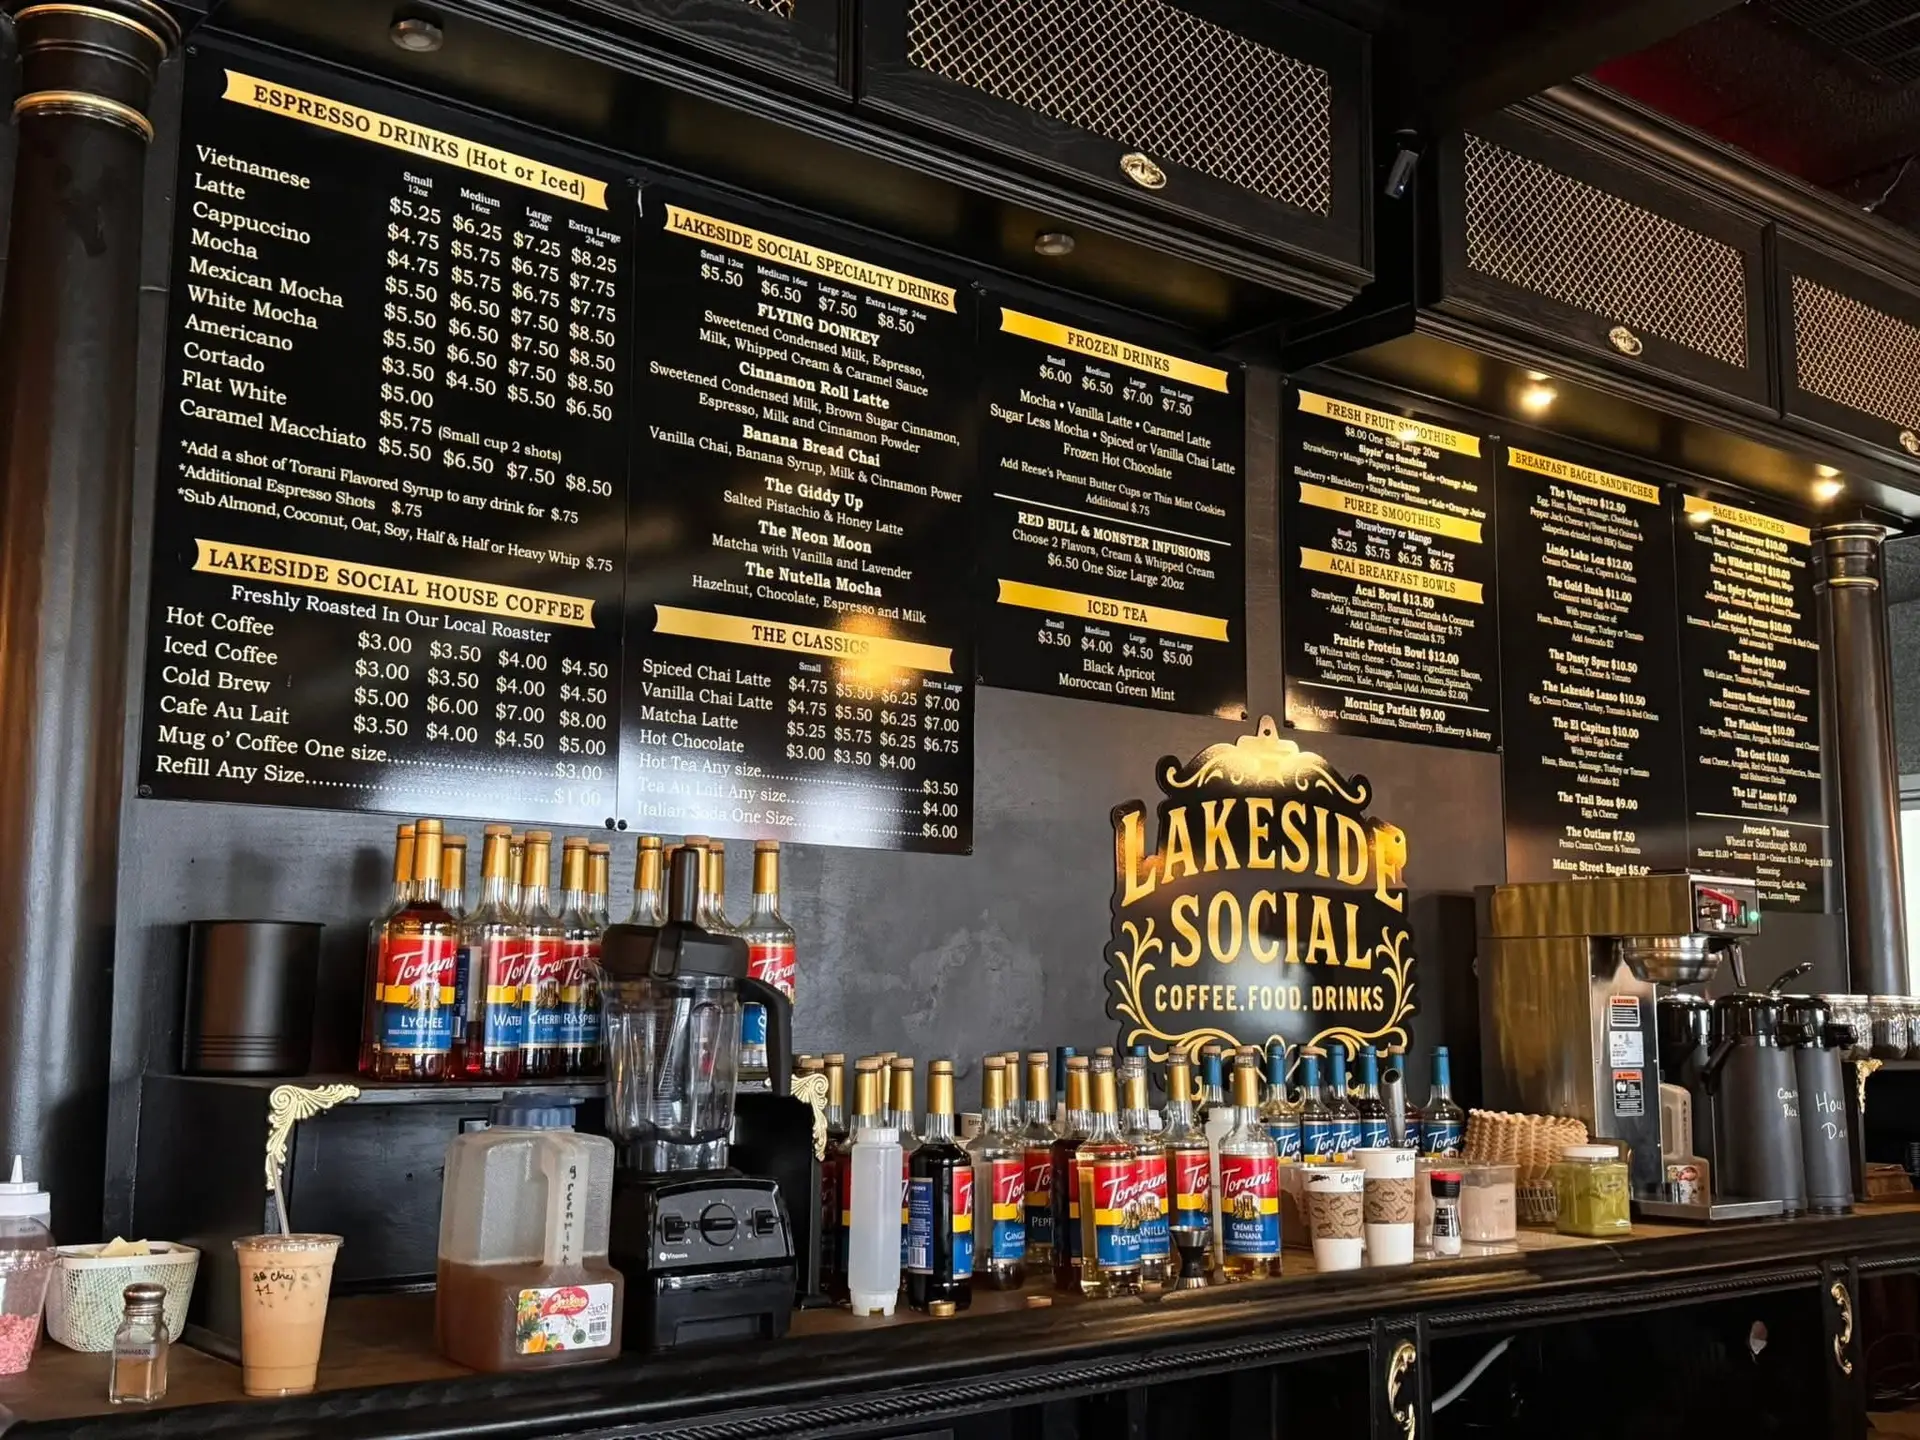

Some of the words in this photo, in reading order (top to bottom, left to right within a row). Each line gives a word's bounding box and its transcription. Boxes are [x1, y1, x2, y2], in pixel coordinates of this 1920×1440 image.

[253, 84, 370, 132] ESPRESSO
[378, 120, 458, 158] DRINKS
[466, 147, 507, 173] (Hot
[514, 166, 534, 180] or
[540, 169, 584, 200] Iced)
[194, 172, 245, 199] Latte
[192, 200, 310, 243] Cappuccino
[196, 144, 310, 189] Vietnamese
[389, 196, 440, 224] $5.25
[452, 213, 502, 241] $6.25
[512, 230, 560, 257] $7.25
[571, 246, 616, 273] $8.25
[403, 171, 432, 188] Small
[460, 187, 500, 207] Medium
[525, 206, 552, 223] Large
[568, 218, 593, 234] Extra
[596, 226, 620, 243] Large
[191, 227, 258, 259] Mocha
[673, 212, 752, 249] LAKESIDE
[757, 237, 812, 266] SOCIAL
[816, 254, 894, 289] SPECIALTY
[897, 278, 948, 306] DRINKS
[189, 255, 272, 290] Mexican
[279, 277, 343, 307] Mocha
[187, 283, 246, 312] White
[252, 298, 318, 329] Mocha
[757, 302, 813, 329] FLYING
[817, 318, 880, 346] DONKEY
[184, 313, 292, 350] Americano
[183, 341, 264, 372] Cortado
[1067, 331, 1118, 357] FROZEN
[1122, 347, 1169, 372] DRINKS
[181, 368, 222, 392] Flat
[228, 378, 286, 405] White
[738, 361, 816, 391] Cinnamon
[819, 380, 848, 399] Roll
[852, 388, 889, 409] Latte
[1039, 364, 1072, 384] $6.00
[1081, 375, 1113, 395] $6.50
[1122, 386, 1153, 405] $7.00
[1162, 396, 1192, 416] $7.50
[179, 398, 263, 429] Caramel
[269, 414, 366, 448] Macchiato
[1326, 401, 1361, 422] FRESH
[1364, 412, 1395, 430] FRUIT
[742, 424, 798, 449] Banana
[802, 437, 844, 459] Bread
[848, 448, 880, 467] Chai
[1515, 452, 1567, 475] BREAKFAST
[1570, 467, 1598, 484] BAGEL
[1599, 474, 1653, 498] SANDWICHES
[266, 478, 331, 501] Espresso
[335, 490, 375, 510] Shots
[391, 500, 422, 517] $.75
[1344, 496, 1378, 515] PUREE
[1381, 505, 1440, 529] SMOOTHIES
[757, 519, 786, 537] The
[791, 525, 828, 545] Neon
[832, 533, 871, 553] Moon
[1017, 511, 1044, 527] RED
[1047, 517, 1078, 534] BULL
[1080, 524, 1090, 537] &
[1092, 526, 1149, 549] MONSTER
[1152, 539, 1210, 562] INFUSIONS
[1712, 505, 1736, 521] BAGEL
[1738, 512, 1785, 534] SANDWICHES
[1331, 536, 1357, 553] $5.25
[1364, 543, 1390, 560] $5.75
[1397, 550, 1422, 566] $6.25
[1429, 556, 1454, 573] $6.75
[208, 548, 328, 582] LAKESIDE
[336, 568, 418, 596] SOCIAL
[425, 581, 498, 607] HOUSE
[505, 593, 584, 620] COFFEE
[744, 560, 774, 578] The
[778, 566, 831, 588] Nutella
[835, 576, 882, 597] Mocha
[1358, 563, 1419, 586] BREAKFAST
[1422, 576, 1455, 593] BOWLS
[1087, 599, 1118, 616] ICED
[1122, 606, 1147, 622] TEA
[166, 605, 204, 627] Hot
[210, 612, 274, 635] Coffee
[357, 630, 411, 653] $3.00
[429, 639, 481, 662] $3.50
[498, 648, 547, 670] $4.00
[561, 656, 608, 678] $4.50
[751, 624, 786, 643] THE
[792, 631, 869, 654] CLASSICS
[1333, 632, 1365, 649] Prairie
[1367, 638, 1402, 655] Protein
[1403, 645, 1426, 659] Bowl
[1428, 648, 1459, 665] $12.00
[162, 665, 210, 686] Cold
[217, 671, 270, 692] Brew
[642, 658, 692, 678] Spiced
[696, 665, 730, 682] Chai
[735, 669, 771, 687] Latte
[788, 675, 827, 694] $4.75
[1083, 658, 1114, 675] Black
[1116, 664, 1155, 681] Apricot
[1548, 647, 1564, 660] The
[1566, 651, 1589, 666] Dusty
[1590, 655, 1609, 668] Spur
[1610, 658, 1637, 673] $10.50
[1058, 672, 1112, 692] Moroccan
[1115, 680, 1147, 697] Green
[1150, 685, 1175, 700] Mint
[1344, 696, 1384, 715] Morning
[1386, 702, 1417, 717] Parfait
[1419, 706, 1445, 721] $9.00
[1557, 790, 1573, 802] The
[1574, 792, 1594, 805] Trail
[1595, 795, 1614, 807] Boss
[1615, 796, 1637, 810] $9.00
[1121, 797, 1406, 912] LAKESIDE
[1170, 890, 1372, 970] SOCIAL
[392, 950, 457, 988] Torani
[401, 1015, 443, 1028] LYCHEE
[1222, 1166, 1272, 1198] Torani
[1234, 1232, 1262, 1240] BANANA
